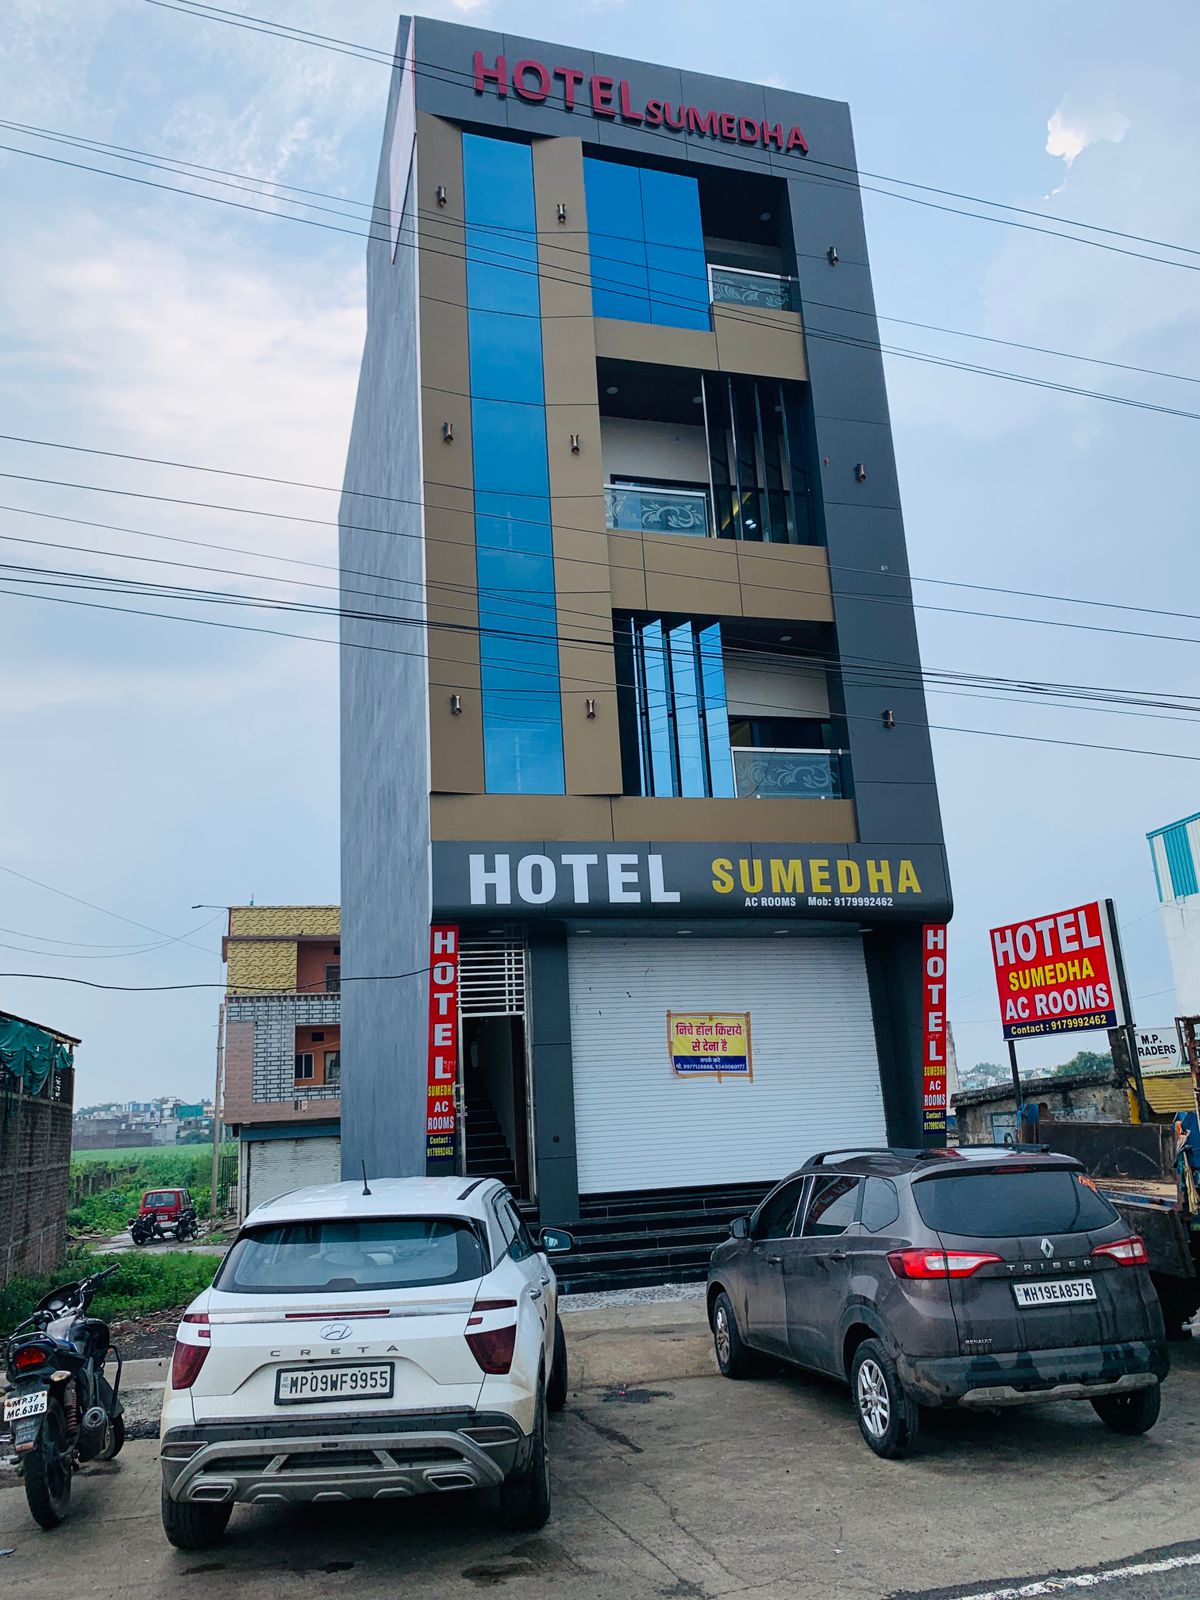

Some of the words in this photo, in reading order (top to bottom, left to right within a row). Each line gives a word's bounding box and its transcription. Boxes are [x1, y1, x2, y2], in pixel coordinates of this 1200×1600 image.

[473, 50, 645, 126] HOTEL
[645, 99, 809, 155] SUMEDHA
[468, 853, 681, 905] HOTEL
[711, 858, 922, 894] SUMEDHA
[745, 897, 758, 907] AC
[761, 896, 796, 907] ROOMS
[808, 896, 831, 906] Mob:
[834, 897, 893, 906] 9179992462
[993, 910, 1101, 967] HOTEL
[1008, 957, 1095, 991] SUMEDHA
[927, 929, 944, 1061] HOTEL
[1005, 996, 1030, 1020] AC
[1034, 983, 1110, 1016] ROOMS
[433, 931, 455, 1079] HOTEL
[675, 1022, 693, 1035] निचे
[695, 1023, 713, 1035] हॉल
[715, 1023, 742, 1035] किराये
[1011, 1023, 1044, 1035] Contact
[1051, 1014, 1107, 1030] 9179992462
[691, 1038, 700, 1051] से
[702, 1039, 719, 1051] देना
[721, 1039, 727, 1051] है
[1141, 1035, 1162, 1044] M.P.
[428, 1084, 453, 1096] SUMEDH
[929, 1080, 942, 1091] AC
[434, 1101, 449, 1113] AC
[924, 1094, 946, 1106] ROOMS
[428, 1116, 455, 1130] ROOMS
[1006, 1259, 1092, 1271] TRIBER
[1022, 1282, 1093, 1302] MH19EA8576
[270, 1345, 399, 1357] CRETA
[289, 1371, 388, 1394] MP09WF9955
